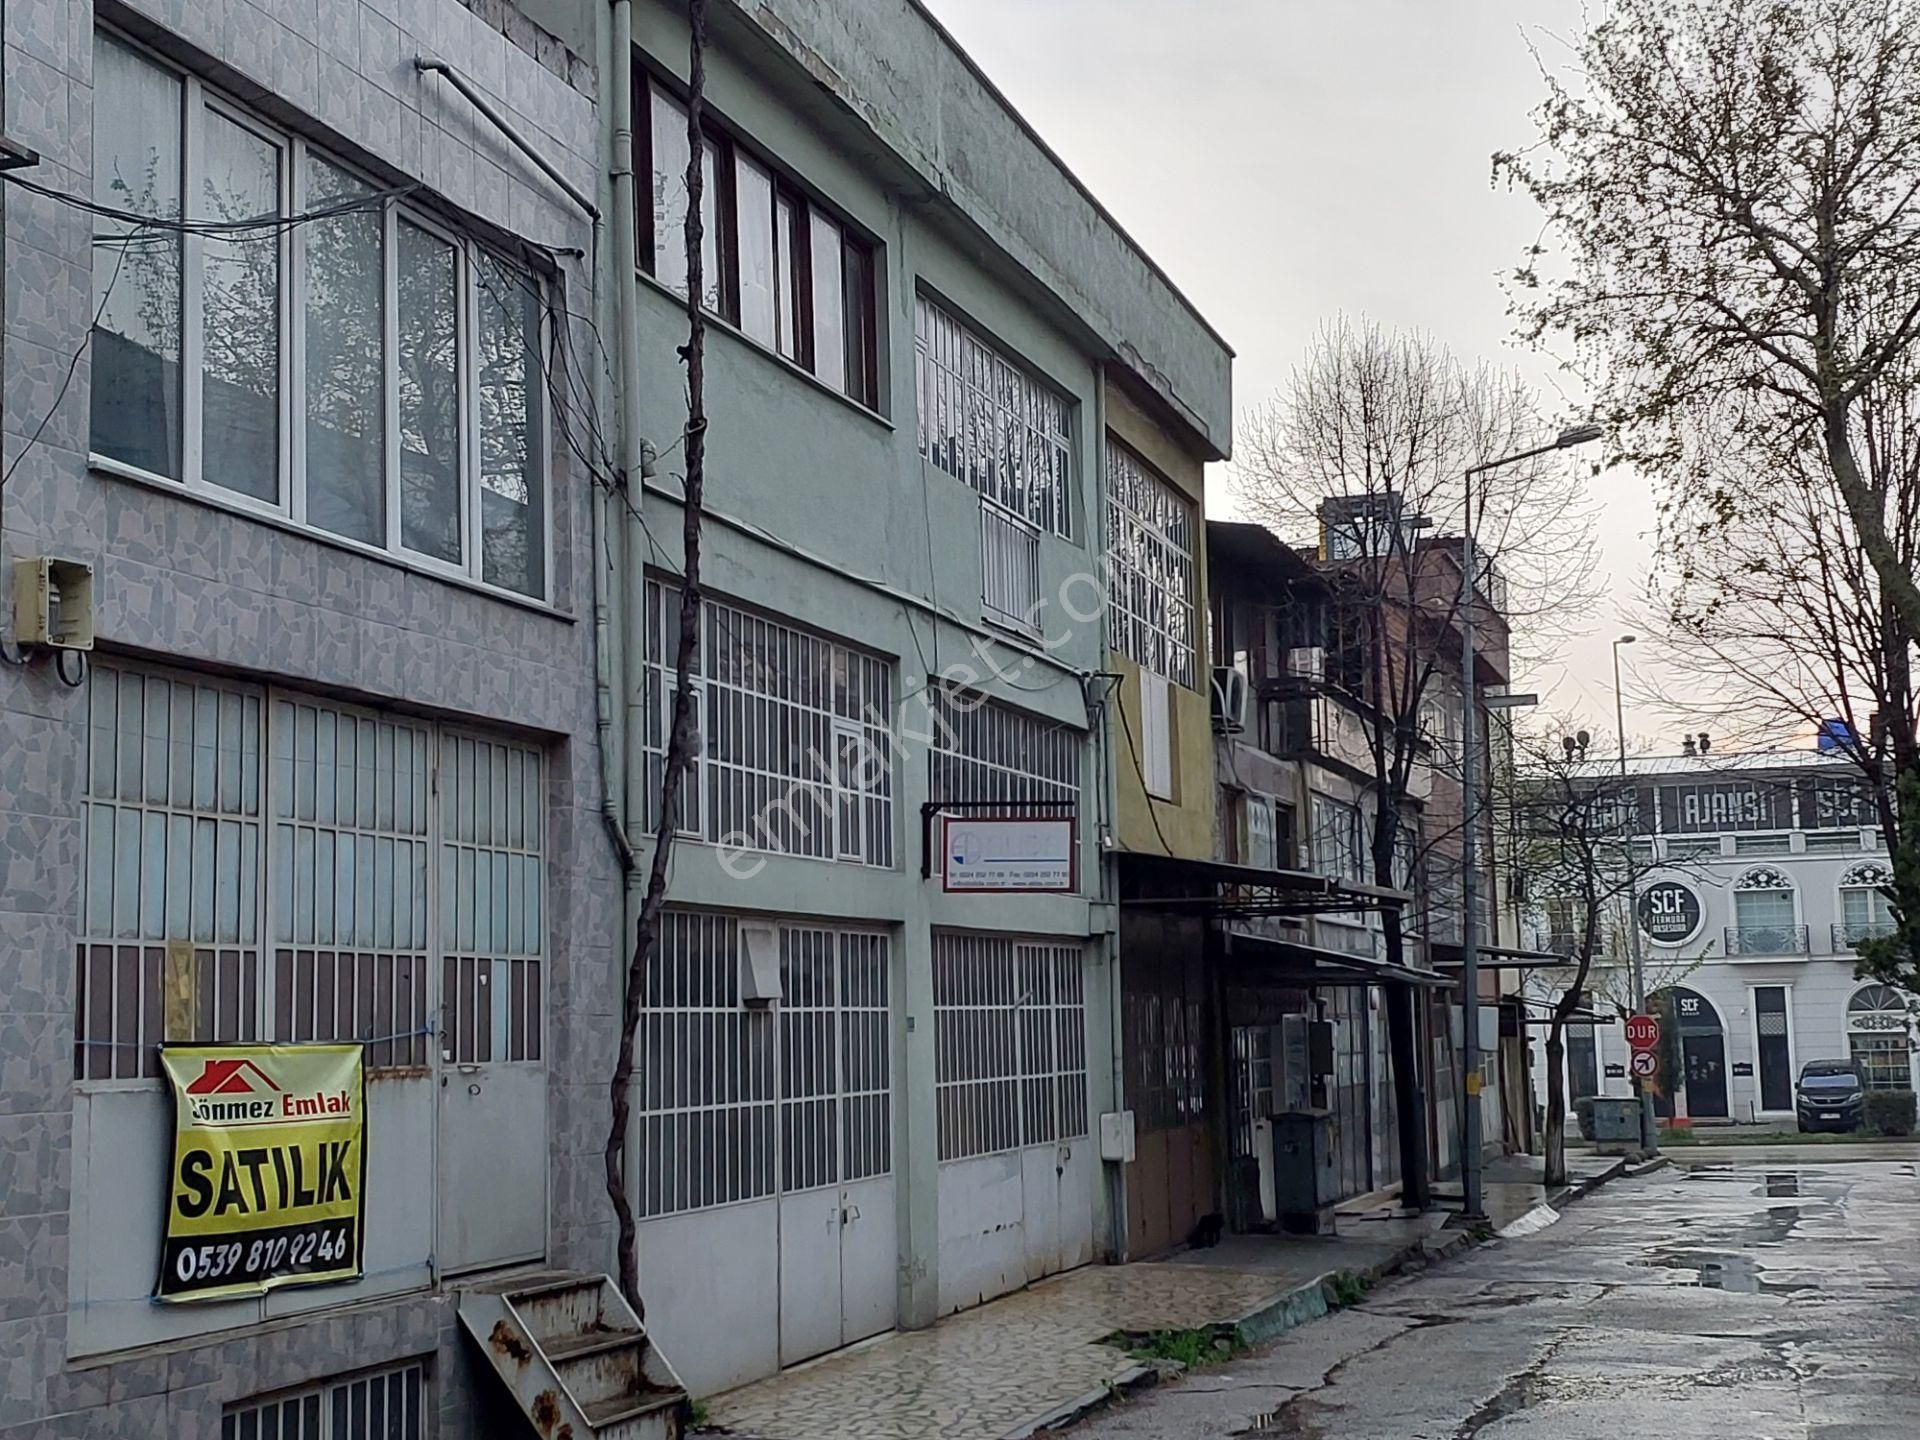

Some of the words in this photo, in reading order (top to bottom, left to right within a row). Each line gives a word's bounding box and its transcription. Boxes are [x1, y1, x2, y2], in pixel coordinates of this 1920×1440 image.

[1650, 889, 1685, 914] SCF
[1680, 998, 1700, 1011] SCF
[1626, 1025, 1657, 1039] DUR
[282, 1090, 351, 1117] Emlak
[177, 1140, 352, 1217] SATILIK
[176, 1242, 242, 1282] 0539
[245, 1236, 288, 1273] 810
